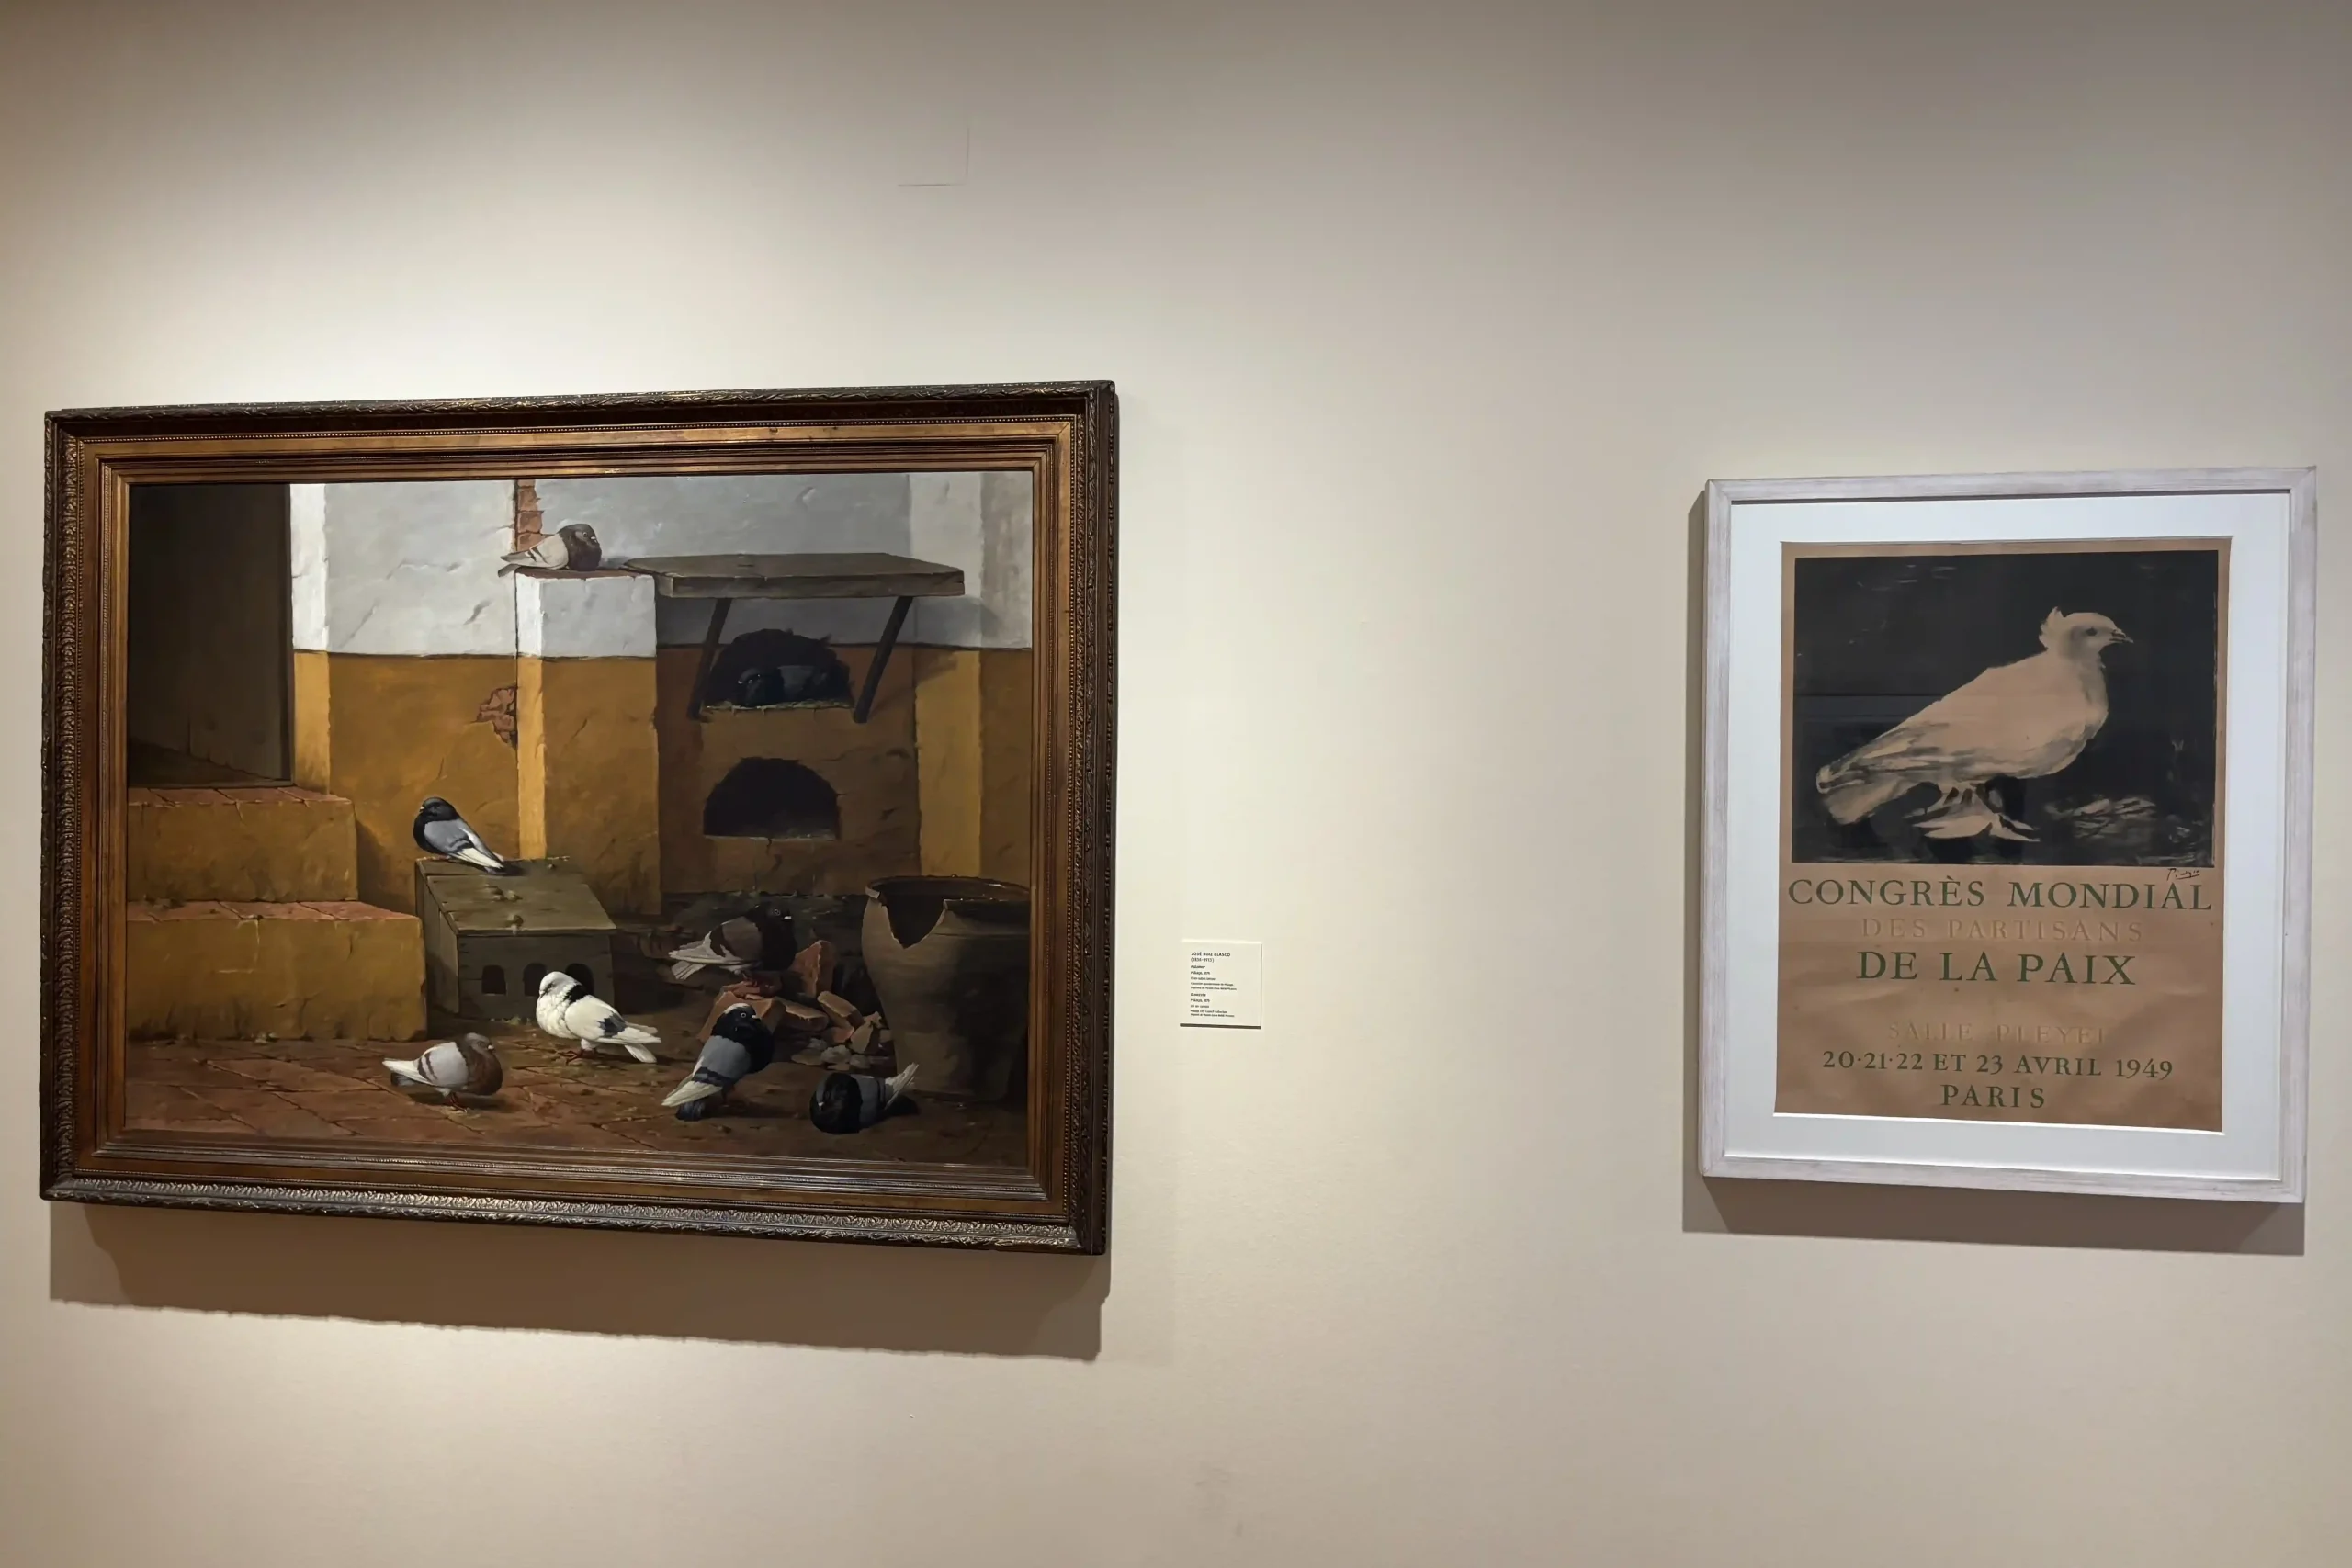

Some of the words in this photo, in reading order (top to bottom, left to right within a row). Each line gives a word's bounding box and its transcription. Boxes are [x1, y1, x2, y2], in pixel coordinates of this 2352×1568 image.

[1788, 875, 1985, 907] CONGRÈS
[2007, 881, 2212, 911] MONDIAL
[1861, 918, 1925, 939] DES
[1947, 919, 2143, 942] PARTISANS
[1856, 951, 1918, 980] DE
[1939, 950, 1997, 982] LA
[2017, 952, 2137, 985] PAIX
[1932, 1053, 1967, 1073] ET
[1976, 1054, 2004, 1076] 23
[2014, 1054, 2102, 1077] AVRIL
[2115, 1057, 2174, 1080] 1949
[1940, 1084, 2046, 1109] PARIS
